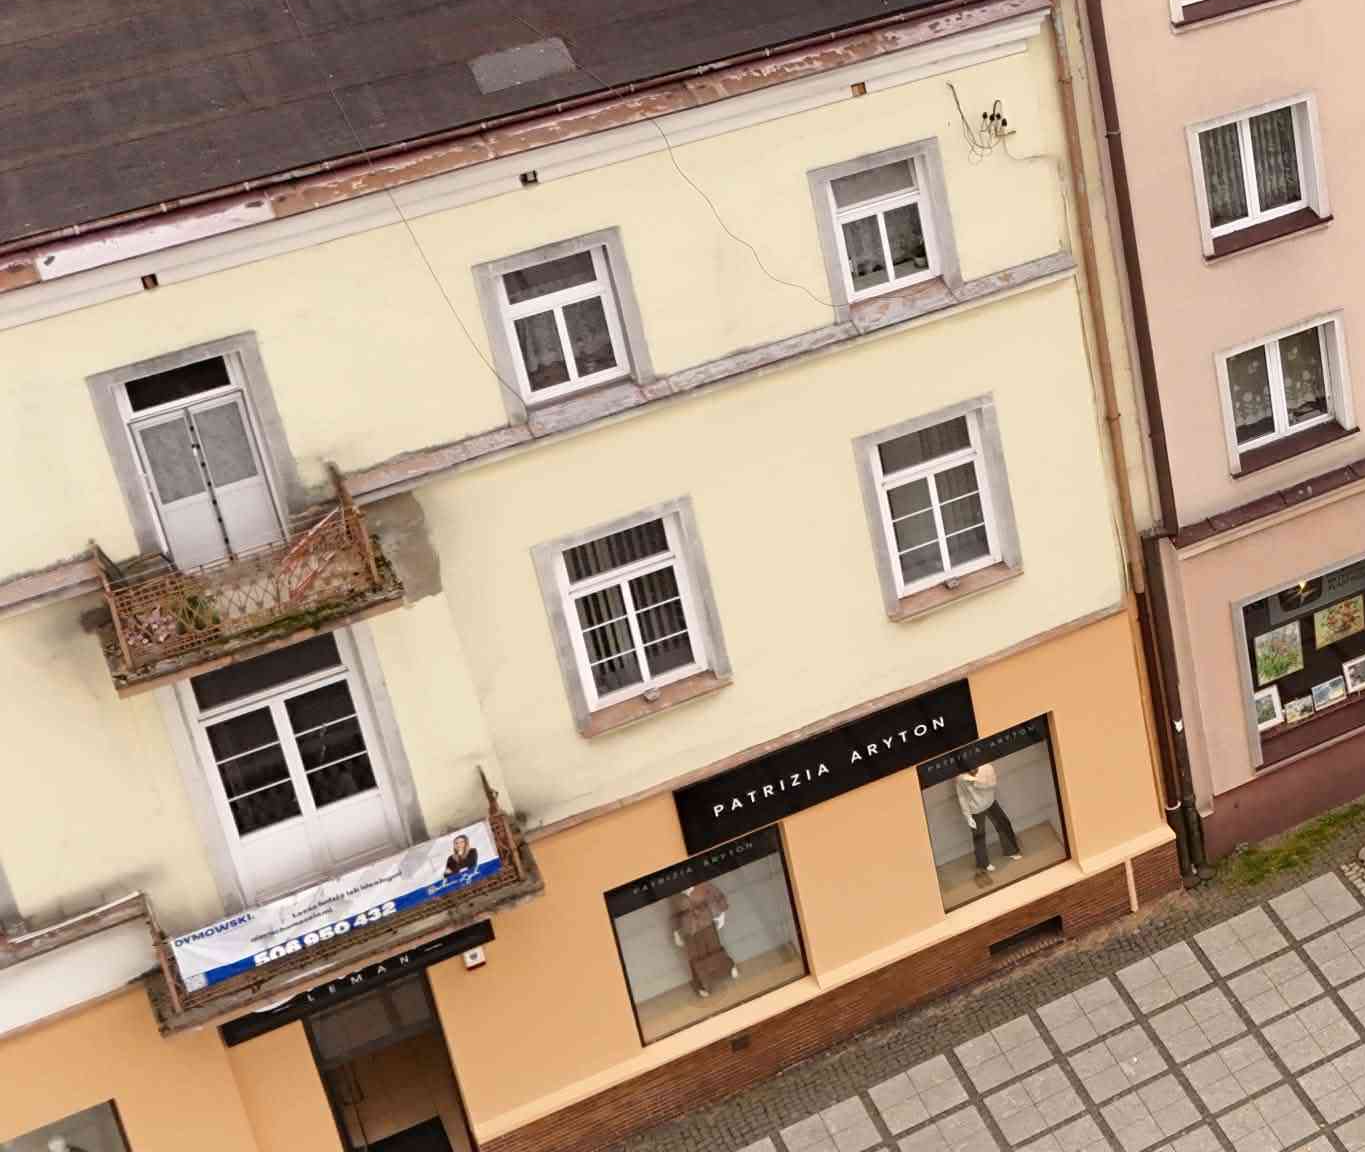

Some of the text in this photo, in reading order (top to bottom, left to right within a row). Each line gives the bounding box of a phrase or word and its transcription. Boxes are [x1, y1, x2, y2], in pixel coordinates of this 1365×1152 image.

[713, 716, 945, 817] PATRIZIA ARYTON
[353, 901, 397, 927] 432
